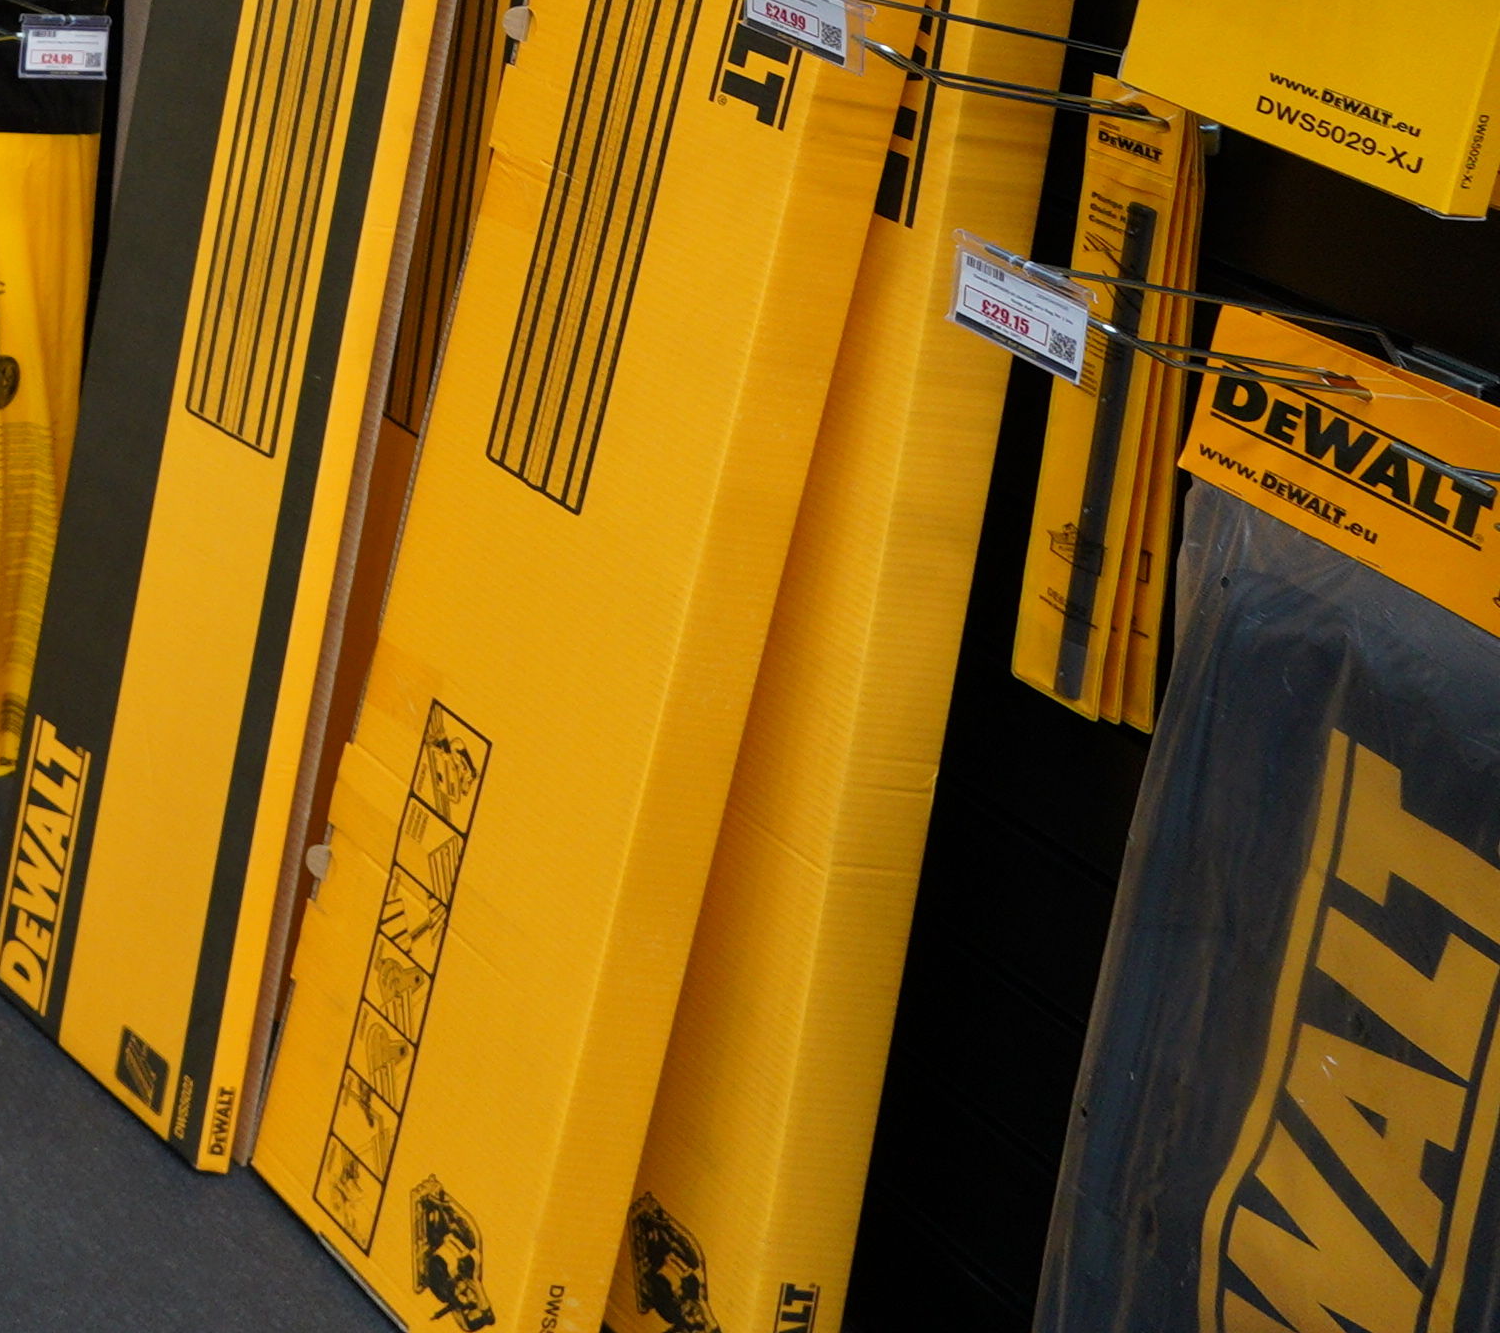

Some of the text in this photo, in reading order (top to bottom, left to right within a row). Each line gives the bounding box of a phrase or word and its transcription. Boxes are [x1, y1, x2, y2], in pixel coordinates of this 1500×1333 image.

[764, 5, 807, 30] £24.99
[41, 54, 73, 64] £24.99
[1098, 130, 1163, 163] DEWALT
[1256, 89, 1423, 173] DWS5029-XJ
[980, 300, 1030, 335] £29.15
[1211, 370, 1496, 539] DEWALT
[208, 1087, 235, 1156] DEWALT
